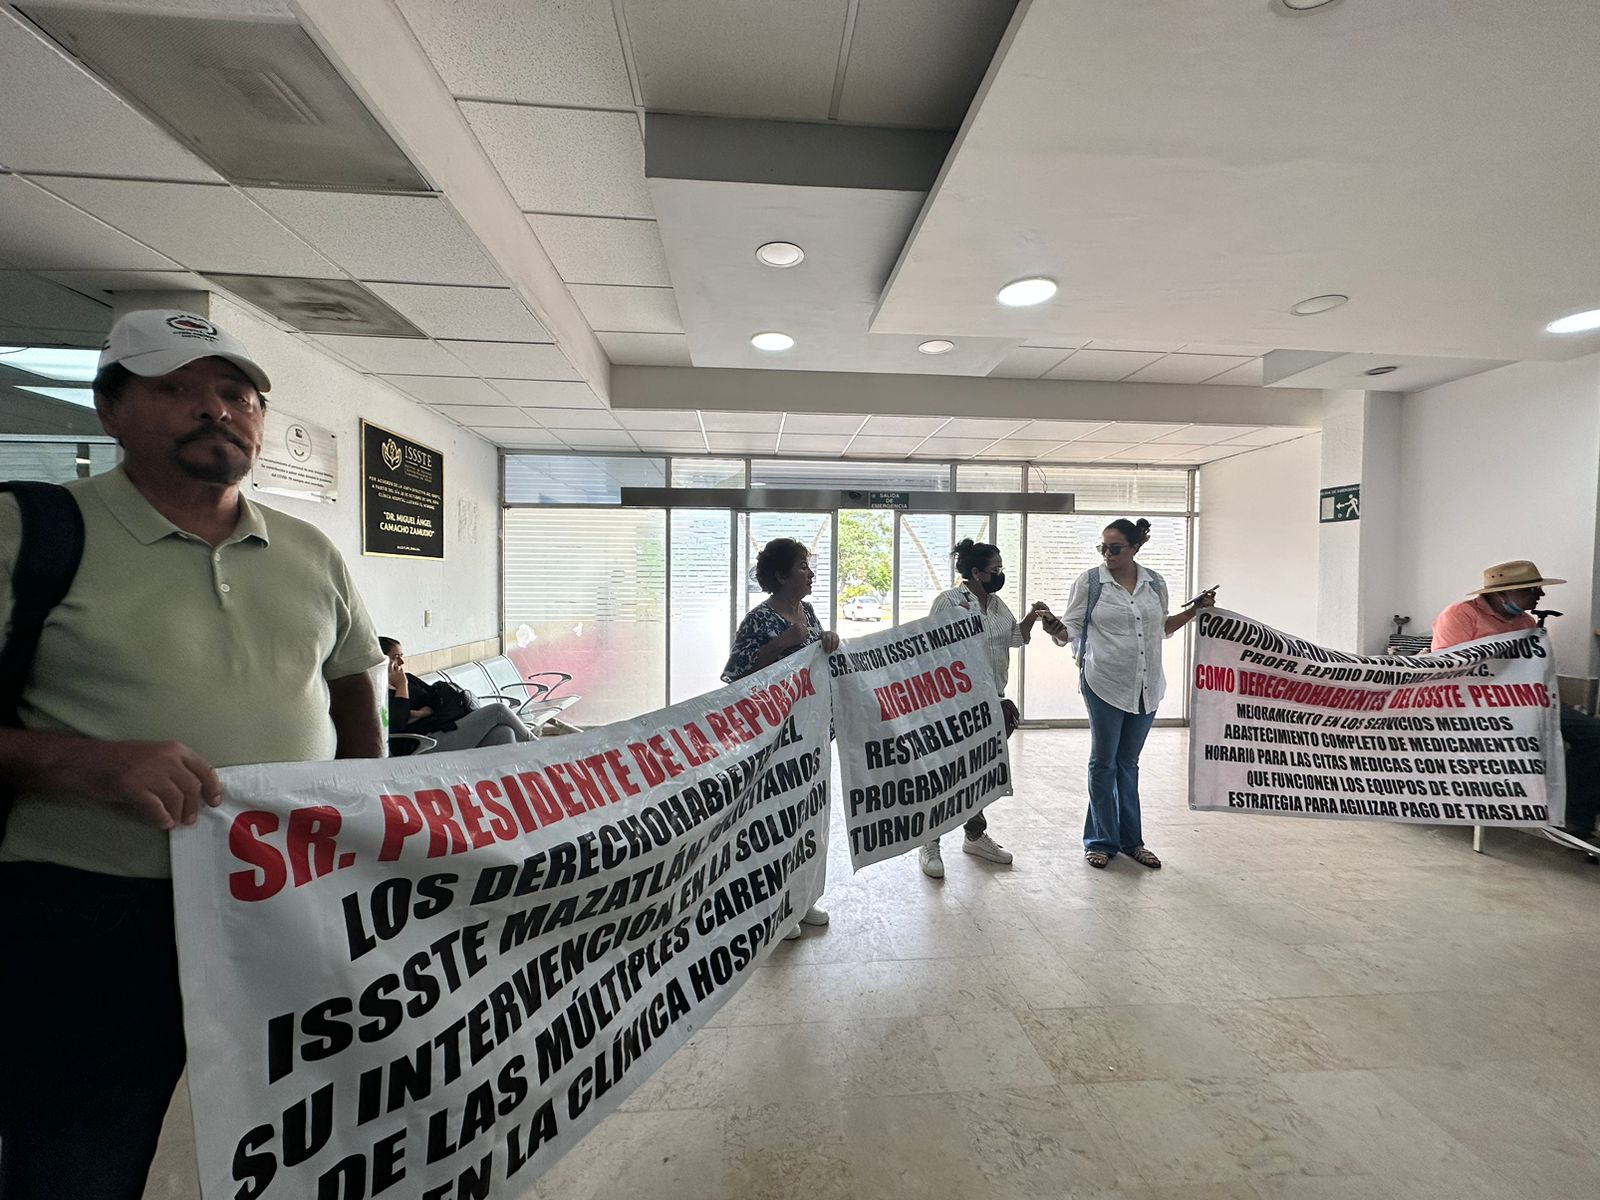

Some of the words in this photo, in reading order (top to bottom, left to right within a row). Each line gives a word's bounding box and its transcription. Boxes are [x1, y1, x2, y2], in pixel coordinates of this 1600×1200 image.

[404, 445, 432, 467] ISSSTE
[379, 522, 409, 534] CAMACHO
[396, 513, 415, 525] MIGUEL
[416, 515, 432, 528] ÁNGEL
[828, 653, 852, 677] SR.
[883, 634, 929, 665] ISSSTE
[926, 613, 985, 650] MAZATLÁN
[1199, 612, 1284, 654] COALICIÓN
[1195, 663, 1235, 693] COMO
[1239, 670, 1391, 712] DERECHOHABIENTES
[1388, 687, 1414, 709] DEL
[1412, 684, 1466, 709] ISSSTE
[1239, 649, 1298, 675] PROFR.
[1302, 664, 1363, 682] ELPIDIO
[865, 699, 992, 770] RESTABLECER
[1224, 724, 1319, 747] ABASTECIMIENTO
[1321, 732, 1386, 751] COMPLETO
[1388, 736, 1407, 751] DE
[1408, 736, 1540, 753] MEDICAMENTOS
[1236, 703, 1323, 726] MEJORAMIENTO
[1322, 715, 1342, 728] EN
[1342, 716, 1363, 730] LOS
[1364, 716, 1435, 732] SERVICIOS
[1434, 716, 1514, 732] MEDICOS
[1205, 744, 1255, 764] HORARIO
[1258, 749, 1289, 766] PARA
[1290, 751, 1312, 768] LAS
[1313, 753, 1348, 771] CITAS
[1350, 756, 1413, 774] MEDICAS
[1415, 758, 1447, 774] CON
[1450, 758, 1546, 775] ESPECIALIS
[1247, 770, 1270, 787] QUE
[1271, 772, 1339, 791] FUNCIONEN
[1340, 776, 1366, 793] LOS
[1368, 778, 1427, 796] EQUIPOS
[1429, 780, 1450, 796] DE
[1451, 778, 1528, 798] CIRUGÍA
[850, 755, 967, 818] PROGRAMA
[850, 811, 925, 857] TURNO
[929, 762, 1008, 830] MATUTINO
[1228, 791, 1302, 812] ESTRATEGIA
[1304, 796, 1338, 814] PARA
[1340, 799, 1399, 817] AGILIZAR
[1400, 801, 1440, 819] PAGO
[1441, 803, 1466, 819] DE
[1466, 804, 1548, 821] TRASLAD
[229, 805, 357, 902] SR.
[377, 748, 641, 862] PRESIDENTE
[627, 733, 685, 788] DE
[668, 721, 720, 768] LA
[267, 920, 490, 1086] ISSSTE
[499, 836, 704, 956] MAZATLÁN
[701, 747, 820, 855] OLICITAMOS
[341, 873, 459, 962] LOS
[232, 1082, 334, 1200] SU
[357, 892, 676, 1127] INTERVENCIÓN
[678, 864, 706, 915] EN
[708, 841, 731, 887] LA
[735, 780, 827, 862] SOLUCIÓN
[317, 1127, 407, 1200] DE
[426, 1054, 528, 1165] LAS
[534, 915, 691, 1086] MÚLTIPLES
[695, 829, 817, 936] CARENCIAS
[506, 1097, 559, 1180] LA
[567, 976, 691, 1120] CLÍNICA
[688, 889, 794, 1003] HOSPITAL
